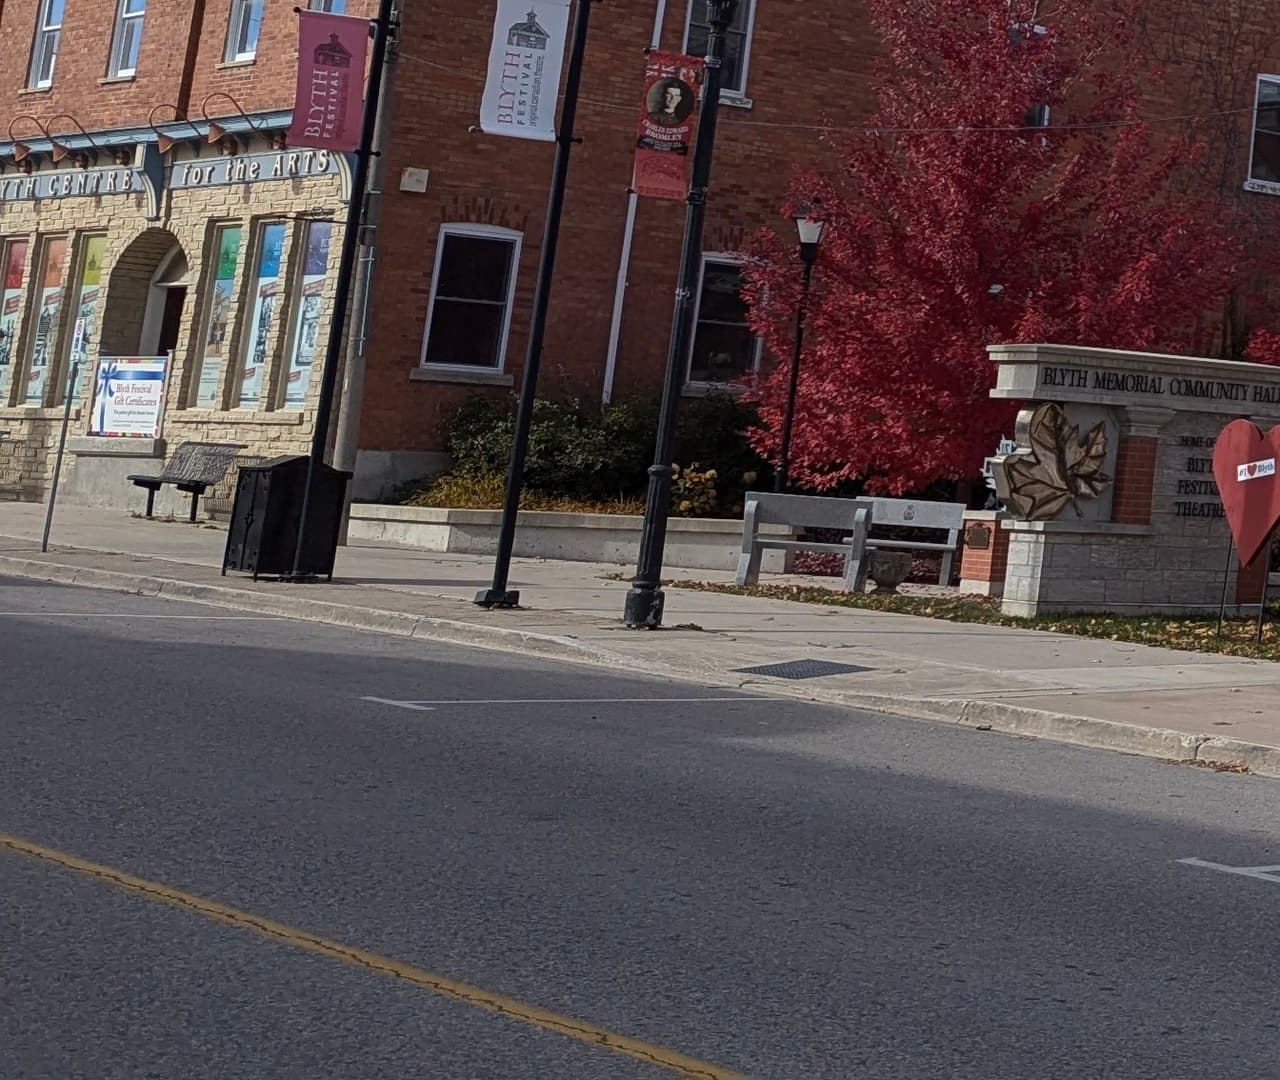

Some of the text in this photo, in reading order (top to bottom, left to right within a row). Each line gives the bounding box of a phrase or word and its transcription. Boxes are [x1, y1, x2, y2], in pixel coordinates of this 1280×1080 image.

[304, 69, 328, 137] BLYTH
[323, 71, 339, 138] FESTIVAL
[497, 51, 521, 125] BLYTH
[517, 53, 533, 126] FESTIVAL
[48, 170, 133, 195] CENTRE
[182, 163, 215, 186] for
[225, 159, 259, 182] the
[271, 149, 330, 176] ARTS
[1043, 368, 1088, 388] BLYTH
[1094, 372, 1165, 395] MEMORIAL
[1169, 378, 1250, 402] COMMUNITY
[1177, 480, 1221, 496] FESTIVA
[1187, 457, 1214, 473] BLYT
[1257, 463, 1274, 474] Blyth
